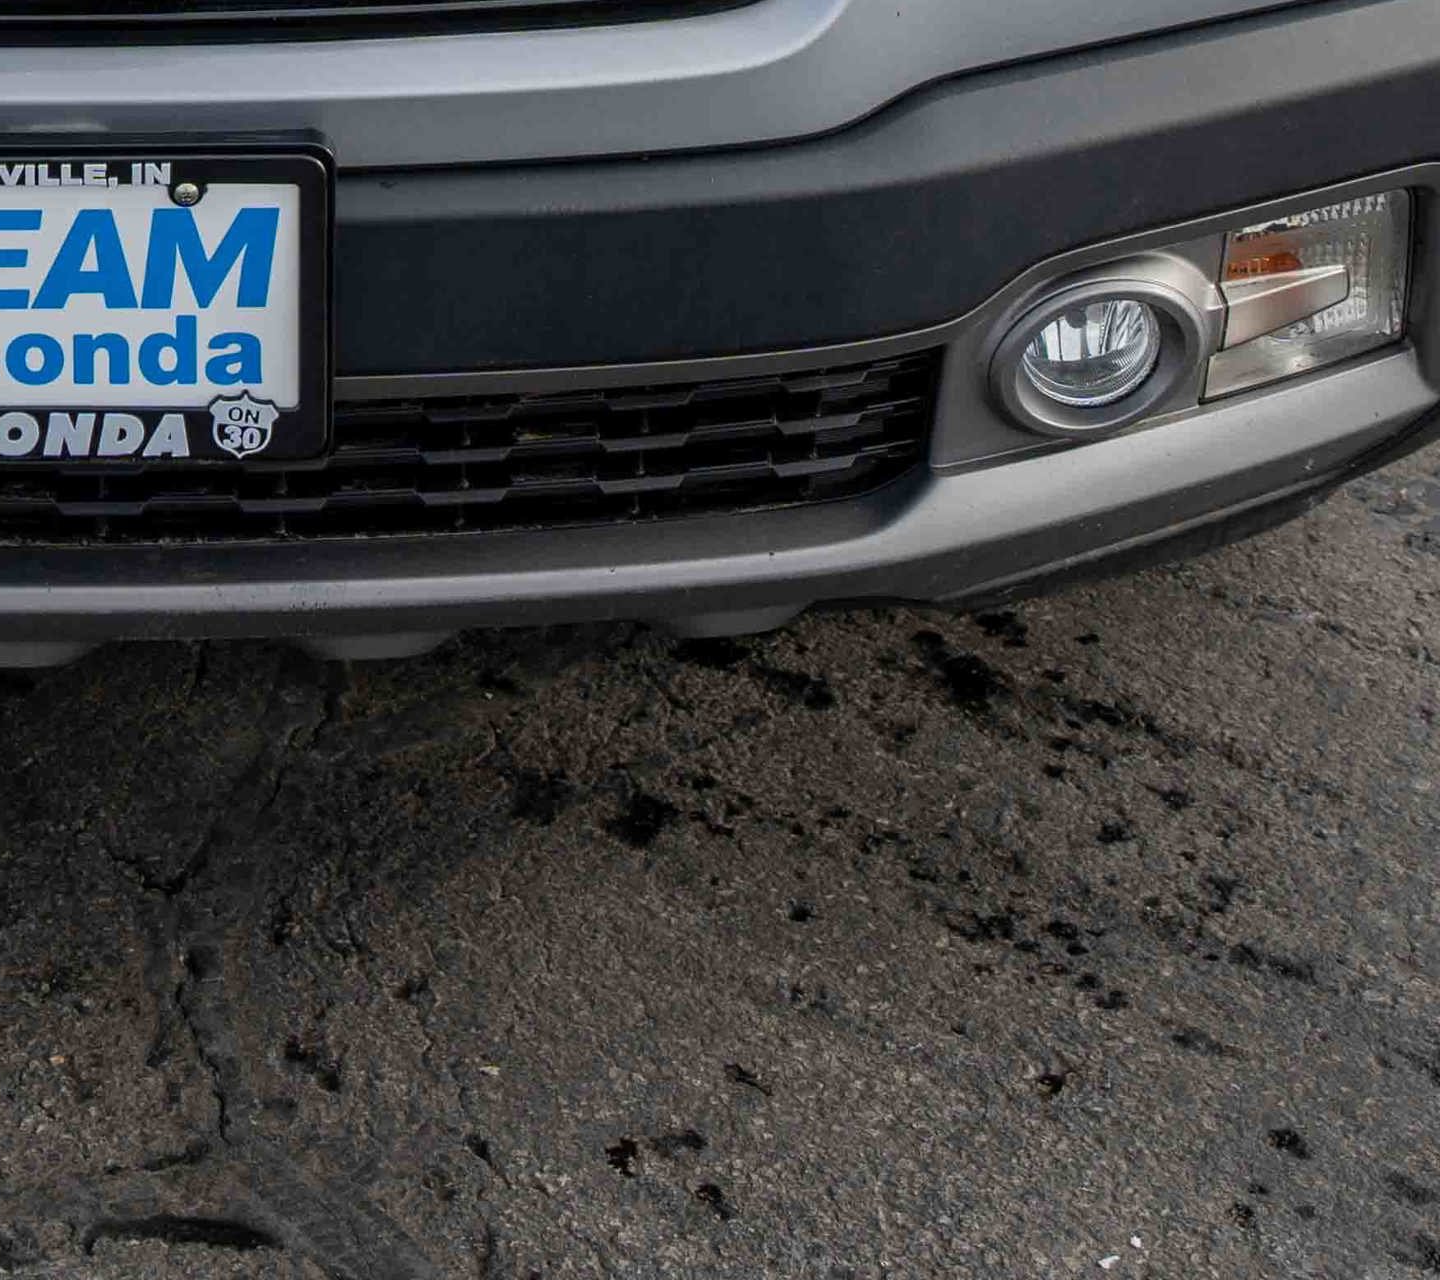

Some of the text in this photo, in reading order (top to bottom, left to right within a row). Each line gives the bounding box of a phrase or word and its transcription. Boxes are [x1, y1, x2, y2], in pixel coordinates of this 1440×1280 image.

[131, 162, 172, 186] IN
[228, 406, 261, 425] ON
[222, 424, 262, 450] 30
